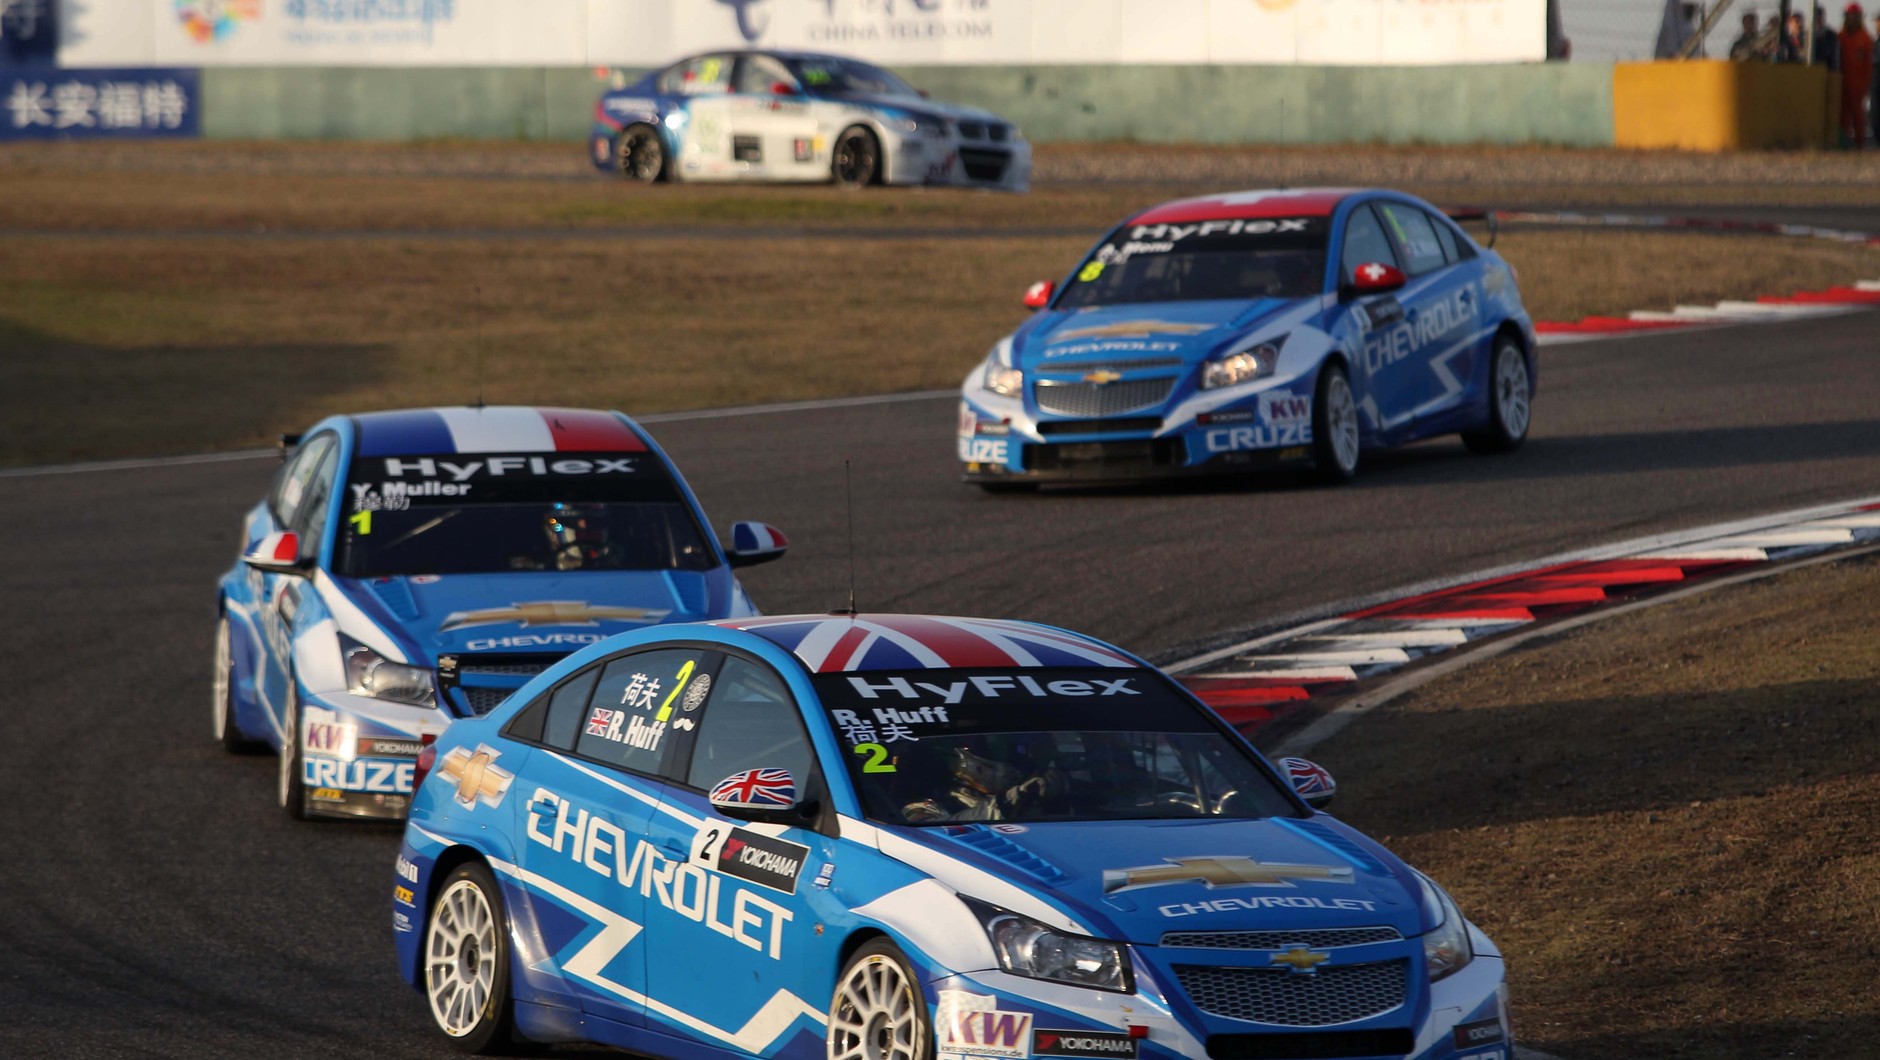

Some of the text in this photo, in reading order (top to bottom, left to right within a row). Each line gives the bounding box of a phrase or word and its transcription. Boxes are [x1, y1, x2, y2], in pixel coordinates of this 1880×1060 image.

[809, 19, 993, 41] CHINA TELECOM
[8, 80, 187, 128] 长安福特
[1132, 219, 1308, 241] HyFlex
[1364, 282, 1478, 376] CHEVROLET
[1045, 342, 1181, 357] CHEVROLET
[1271, 397, 1306, 419] KW
[1207, 424, 1312, 451] CRUZE
[385, 457, 634, 481] HyFlex
[351, 481, 472, 498] Y. Muller
[350, 509, 371, 535] 1
[620, 672, 661, 711] 荷夫
[655, 659, 695, 722] 2
[847, 675, 1142, 704] HyFlex
[831, 706, 949, 725] R. Huff
[605, 710, 667, 751] R. Huff
[840, 723, 919, 744] 荷夫
[854, 743, 897, 773] 2
[303, 757, 414, 793] CRUZE
[700, 829, 719, 861] 2
[738, 845, 798, 878] YOKOHAMA
[526, 787, 794, 960] CHEVROLET
[1158, 896, 1376, 917] CHEVROLET
[948, 1011, 1030, 1047] KW
[1060, 1037, 1133, 1052] YOKOHAMA
